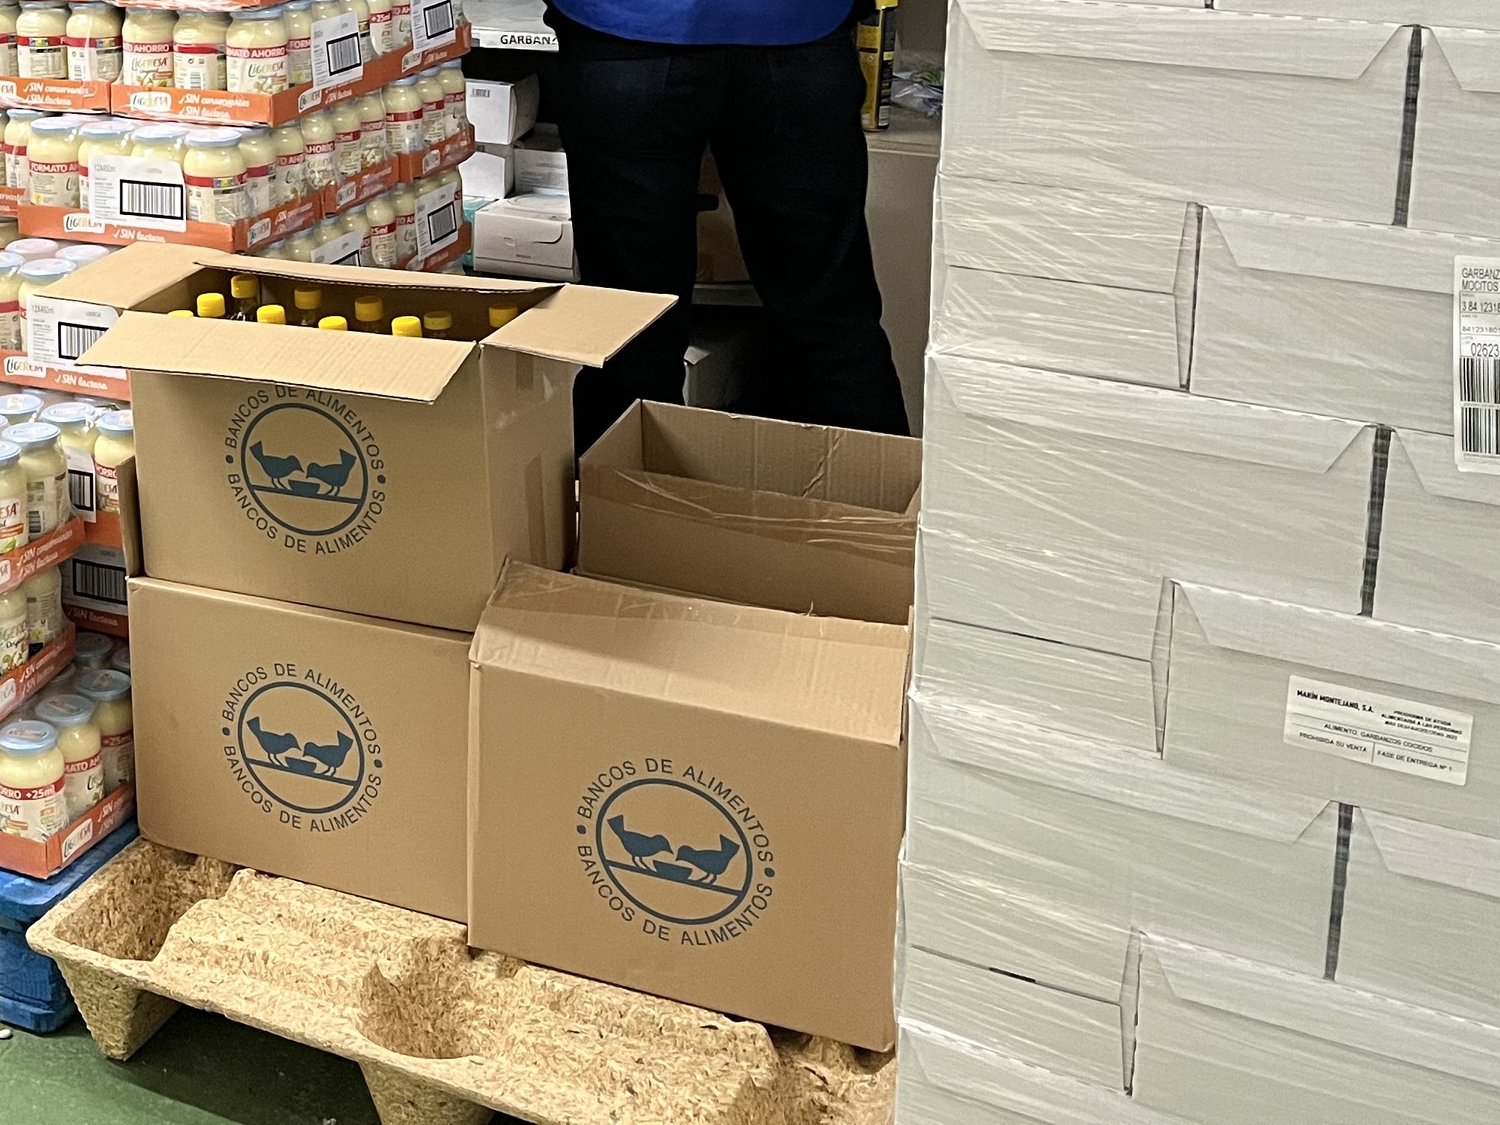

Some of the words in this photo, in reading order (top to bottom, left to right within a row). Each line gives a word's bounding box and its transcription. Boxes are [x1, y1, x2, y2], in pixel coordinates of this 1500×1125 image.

[371, 13, 392, 23] +25ml
[133, 44, 169, 52] AHORRO
[120, 230, 135, 239] SIN
[137, 233, 165, 242] lactosa
[1462, 279, 1499, 292] MOCITOS
[1462, 301, 1467, 311] 3
[1468, 301, 1477, 312] 84
[1470, 342, 1499, 357] 02623
[61, 375, 77, 385] SIN
[78, 377, 108, 390] lactosa
[225, 389, 269, 449] BANCOS
[275, 385, 298, 398] DE
[306, 389, 385, 471] ALIMENTOS
[228, 473, 278, 540] BANCOS
[284, 535, 307, 553] DE
[315, 490, 385, 555] ALIMENTOS
[222, 667, 268, 722] BANCOS
[274, 663, 297, 677] DE
[304, 668, 381, 754] ALIMENTOS
[1297, 690, 1319, 701] MARÍN
[1319, 695, 1361, 711] MONTEJANO,
[1362, 704, 1374, 713] S.A.
[1299, 732, 1334, 745] PROHIBIDA
[1346, 742, 1367, 752] VENTA
[1361, 732, 1401, 746] GARBANZOS
[1403, 740, 1433, 752] COCIDOS
[1377, 750, 1394, 759] FASE
[1406, 756, 1438, 770] ENTREGA
[223, 745, 273, 813] BANCOS
[279, 810, 302, 829] DE
[310, 773, 382, 832] ALIMENTOS
[577, 761, 636, 819] BANCOS
[645, 757, 673, 774] DE
[683, 765, 774, 863] ALIMENTOS
[577, 845, 635, 922] BANCOS
[643, 919, 670, 941] DE
[681, 883, 773, 946] ALIMENTOS
